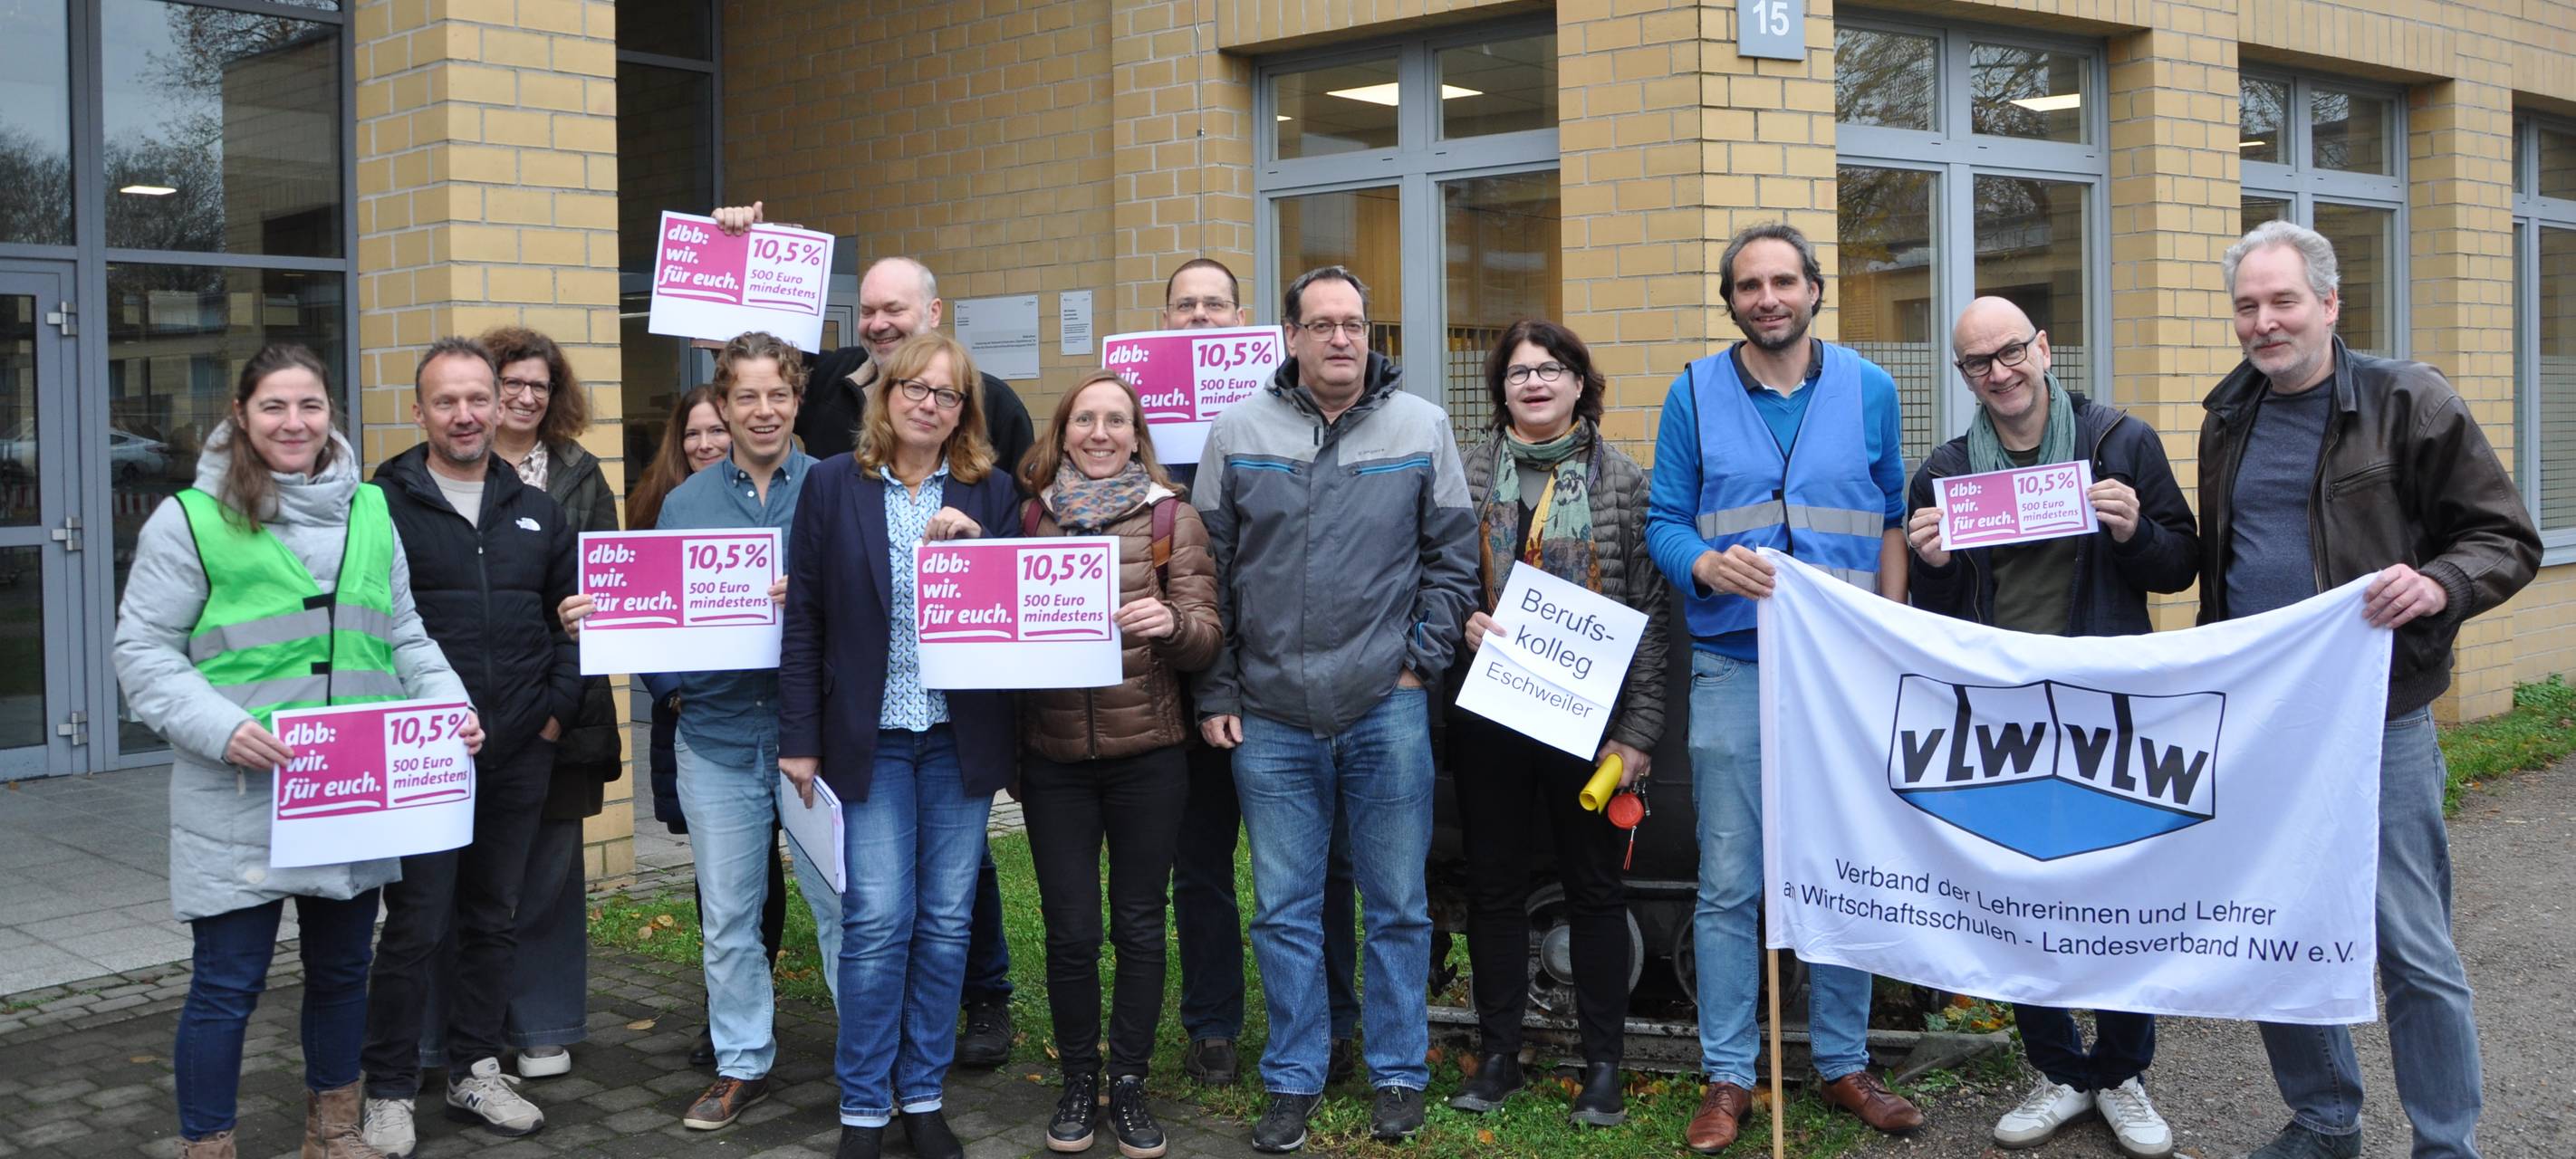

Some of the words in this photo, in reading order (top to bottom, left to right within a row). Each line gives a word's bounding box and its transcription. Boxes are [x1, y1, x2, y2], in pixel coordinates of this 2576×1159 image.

[1753, 0, 1790, 36] 15
[668, 225, 709, 244] dbb:
[666, 246, 699, 263] wir.
[659, 265, 691, 285] für
[692, 272, 739, 290] euch.
[751, 270, 774, 281] 500
[776, 273, 803, 284] Euro
[749, 283, 816, 299] mindestens
[1109, 344, 1149, 364] dbb:
[1200, 379, 1224, 391] 500
[1228, 378, 1257, 389] Euro
[1140, 388, 1190, 407] euch.
[1949, 482, 1982, 498] dbb:
[1952, 499, 1978, 513] wir.
[2022, 502, 2041, 512] 500
[2043, 500, 2064, 509] Euro
[2023, 509, 2079, 522] mindestens
[1952, 516, 1975, 534] für
[1977, 511, 2015, 527] euch.
[588, 544, 636, 564] dbb:
[922, 553, 971, 574] dbb:
[589, 568, 628, 588] wir.
[689, 582, 716, 594] 500
[719, 581, 750, 593] Euro
[923, 578, 962, 599] wir.
[623, 590, 678, 611] euch.
[689, 596, 768, 609] mindestens
[1024, 594, 1050, 607] 500
[1053, 594, 1085, 607] Euro
[919, 604, 954, 630] für
[957, 603, 1013, 624] euch.
[1024, 608, 1103, 623] mindestens
[1521, 588, 1615, 642] Berufs-
[1515, 624, 1593, 680] kolleg
[1485, 661, 1593, 718] Eschweiler
[284, 722, 336, 746] dbb:
[286, 750, 329, 772] wir.
[392, 758, 418, 773] 500
[423, 756, 453, 770] Euro
[279, 778, 320, 807] für
[324, 771, 381, 797] euch.
[393, 771, 467, 789] mindestens
[1835, 858, 1929, 894] Verband
[1938, 879, 1970, 903] der
[1977, 891, 2129, 924] Lehrerinnen
[2139, 902, 2187, 924] und
[2196, 900, 2276, 925] Lehrer
[1802, 885, 2017, 945] Wirtschaftsschulen
[2043, 932, 2238, 957] Landesverband
[2248, 937, 2299, 963] NW
[466, 1093, 481, 1107] N
